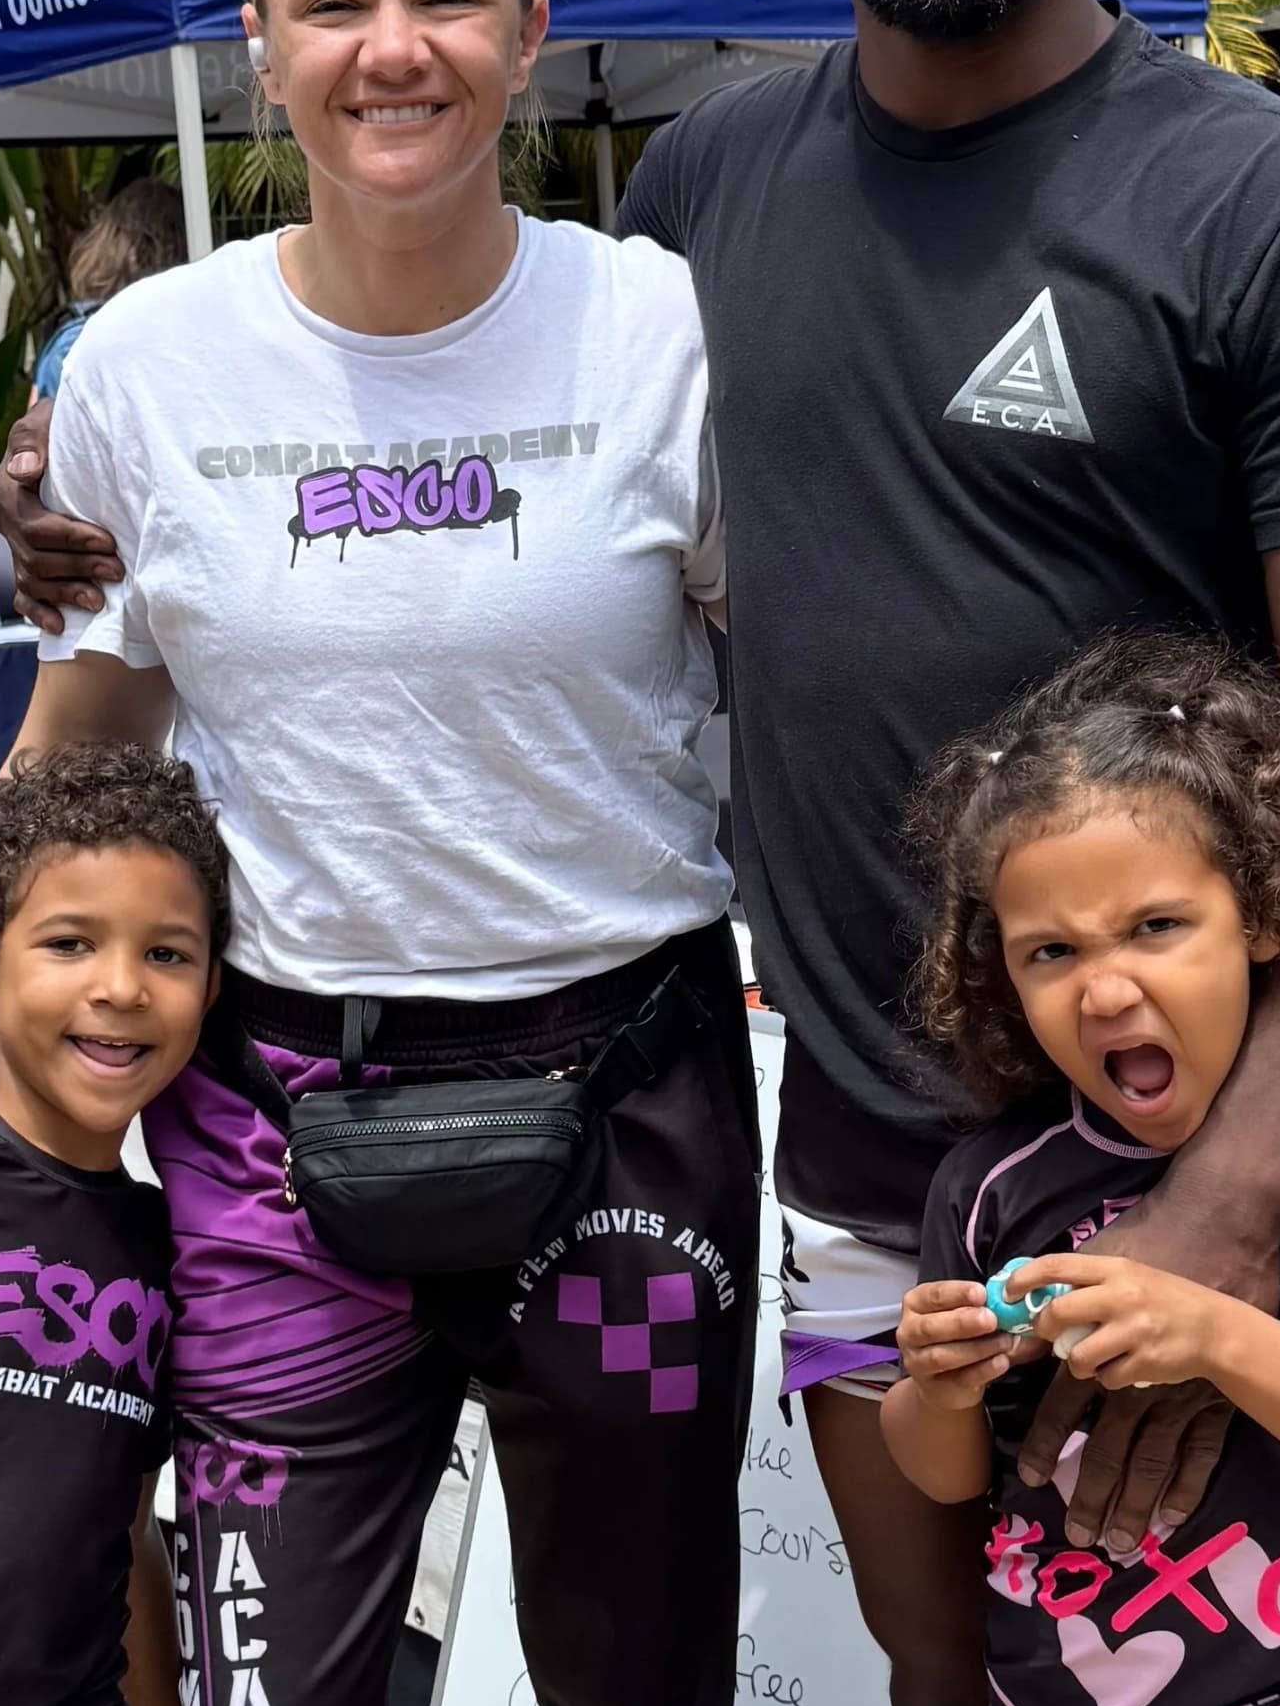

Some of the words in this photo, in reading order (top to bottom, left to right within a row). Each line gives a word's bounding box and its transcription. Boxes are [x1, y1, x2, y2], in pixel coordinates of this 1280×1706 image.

[197, 443, 376, 480] COMBAT
[385, 422, 601, 471] ACADEMY
[296, 454, 498, 539] ESCO
[575, 1208, 667, 1241] MOVES
[672, 1227, 735, 1311] AHEAD
[66, 1381, 156, 1428] ACADEMY
[746, 1428, 793, 1480] the
[740, 1508, 852, 1575] Cours
